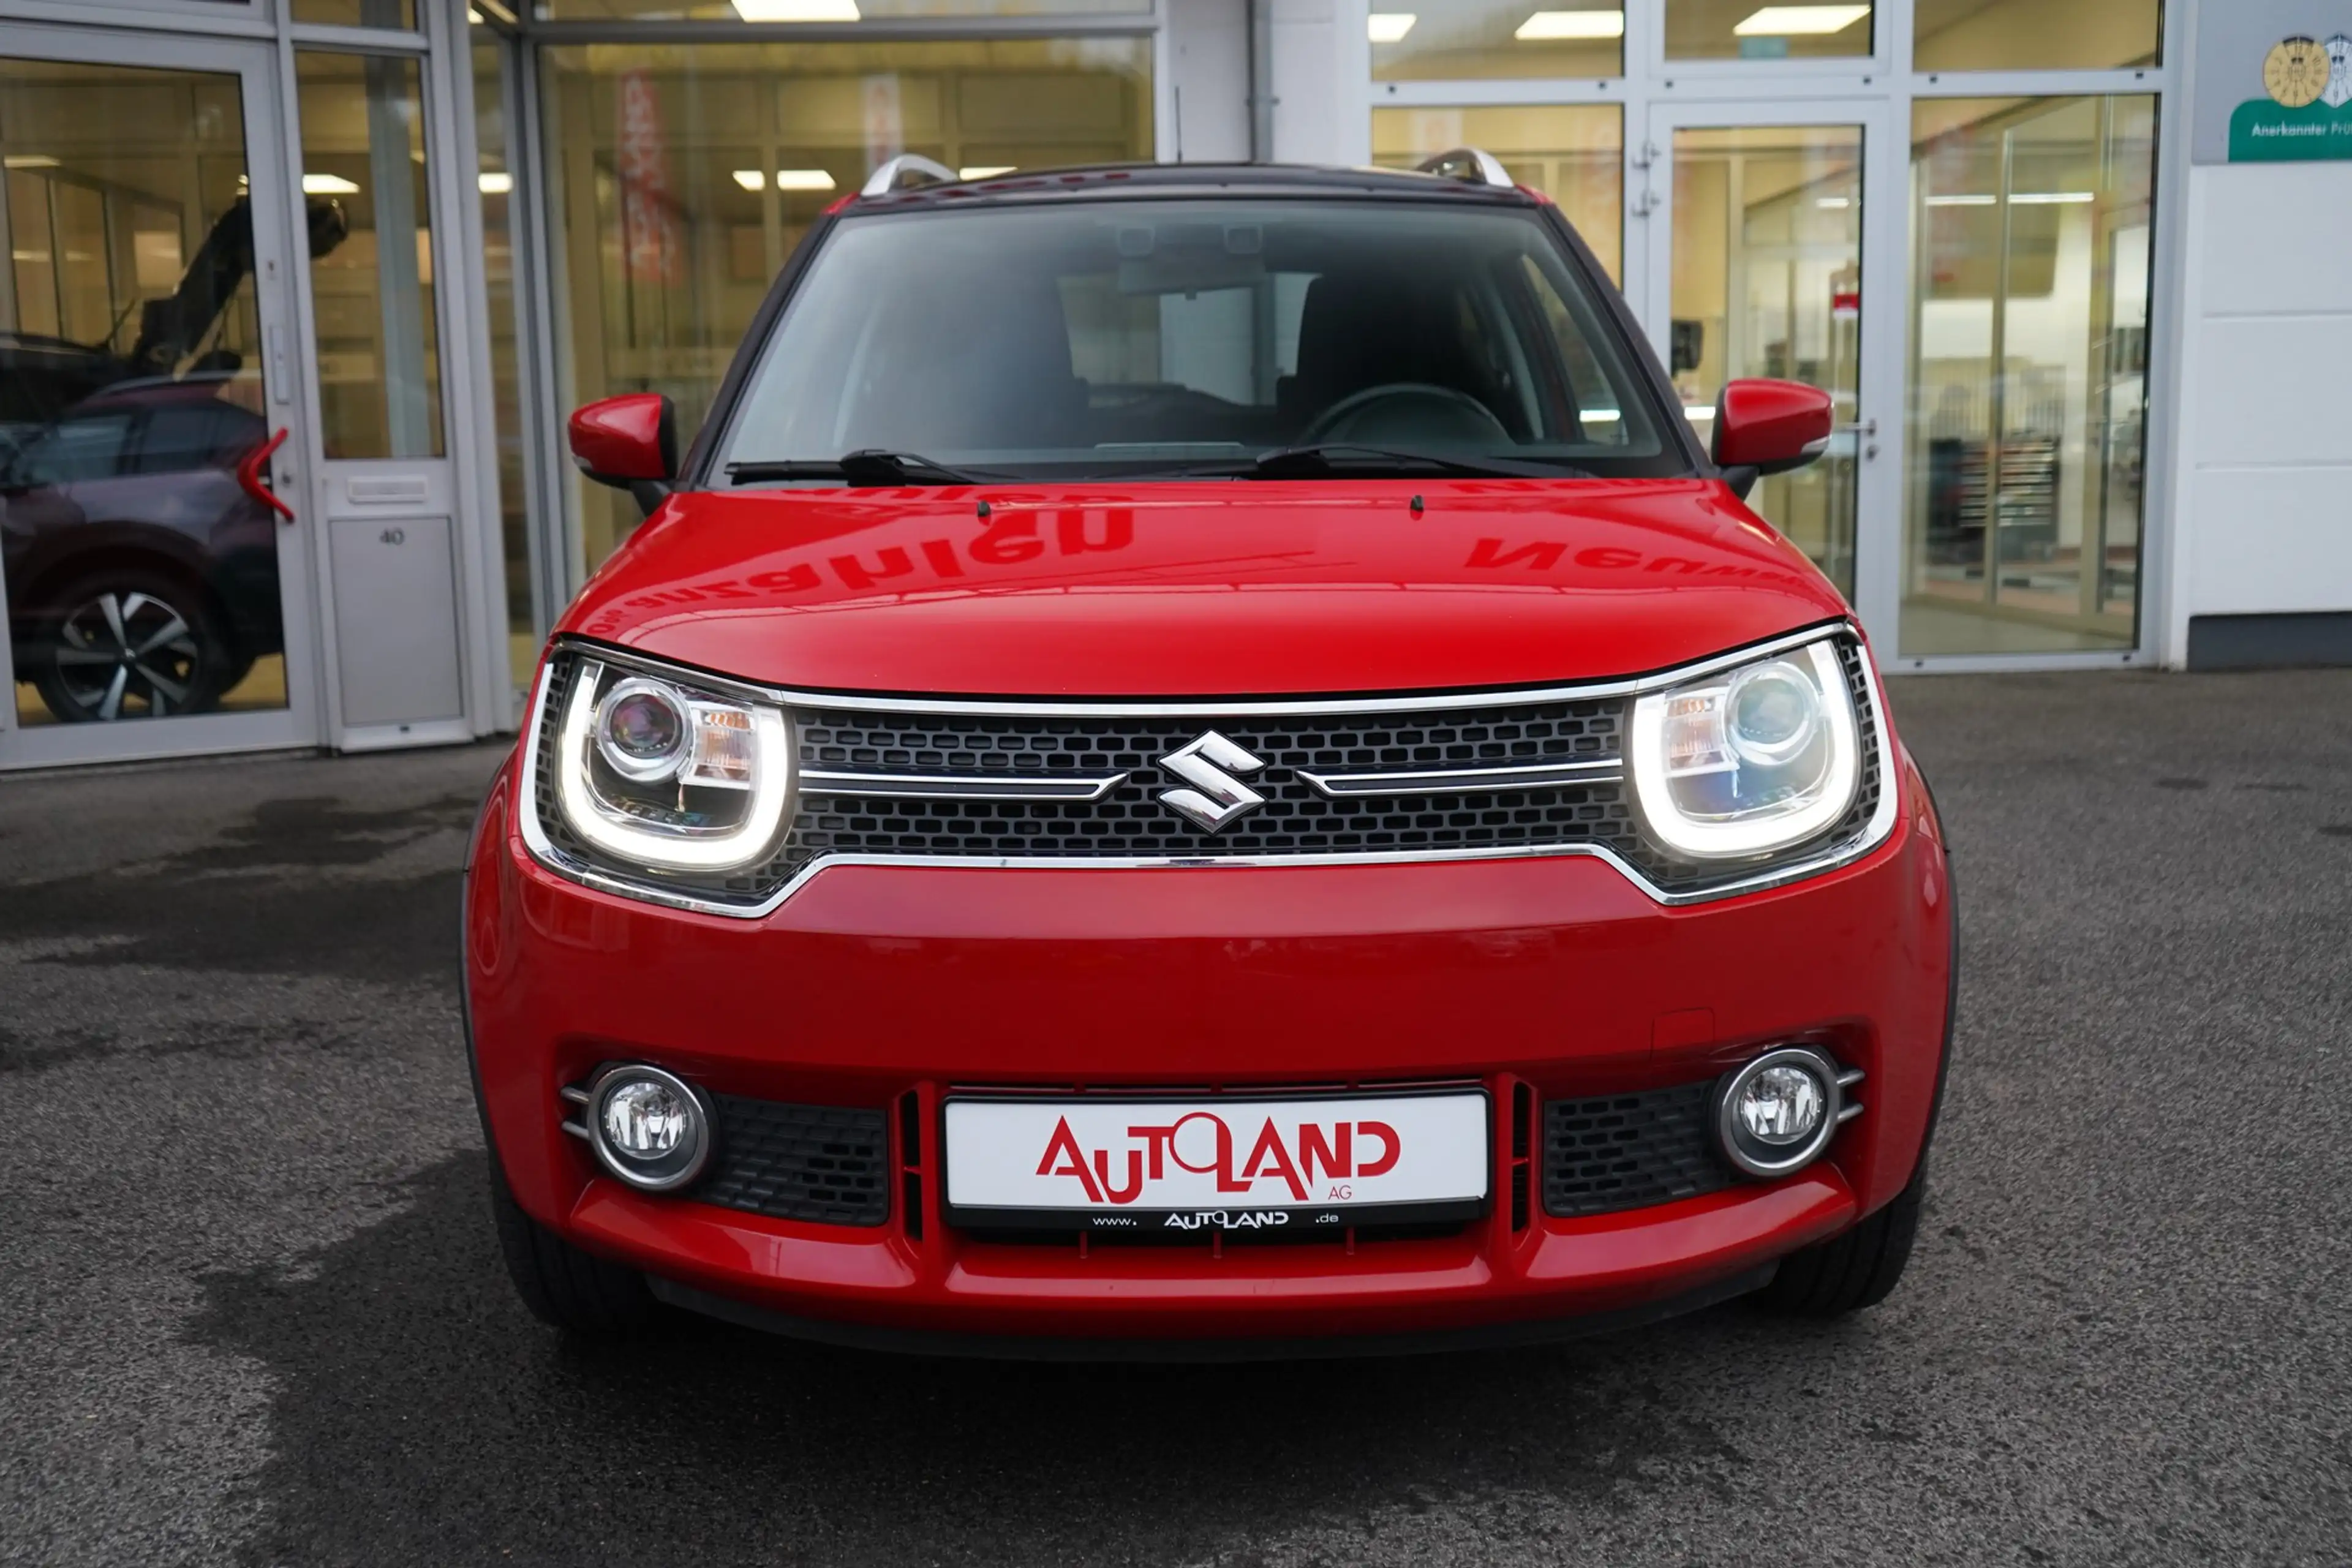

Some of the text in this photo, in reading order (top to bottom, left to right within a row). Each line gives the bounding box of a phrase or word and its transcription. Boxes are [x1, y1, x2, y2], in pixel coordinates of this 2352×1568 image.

[2252, 121, 2327, 137] Anerkannter
[379, 527, 405, 545] 40
[1035, 1111, 1401, 1205] AUTOLAND
[1328, 1185, 1352, 1201] AG
[1093, 1210, 1339, 1230] www. AUTOLAND .de
